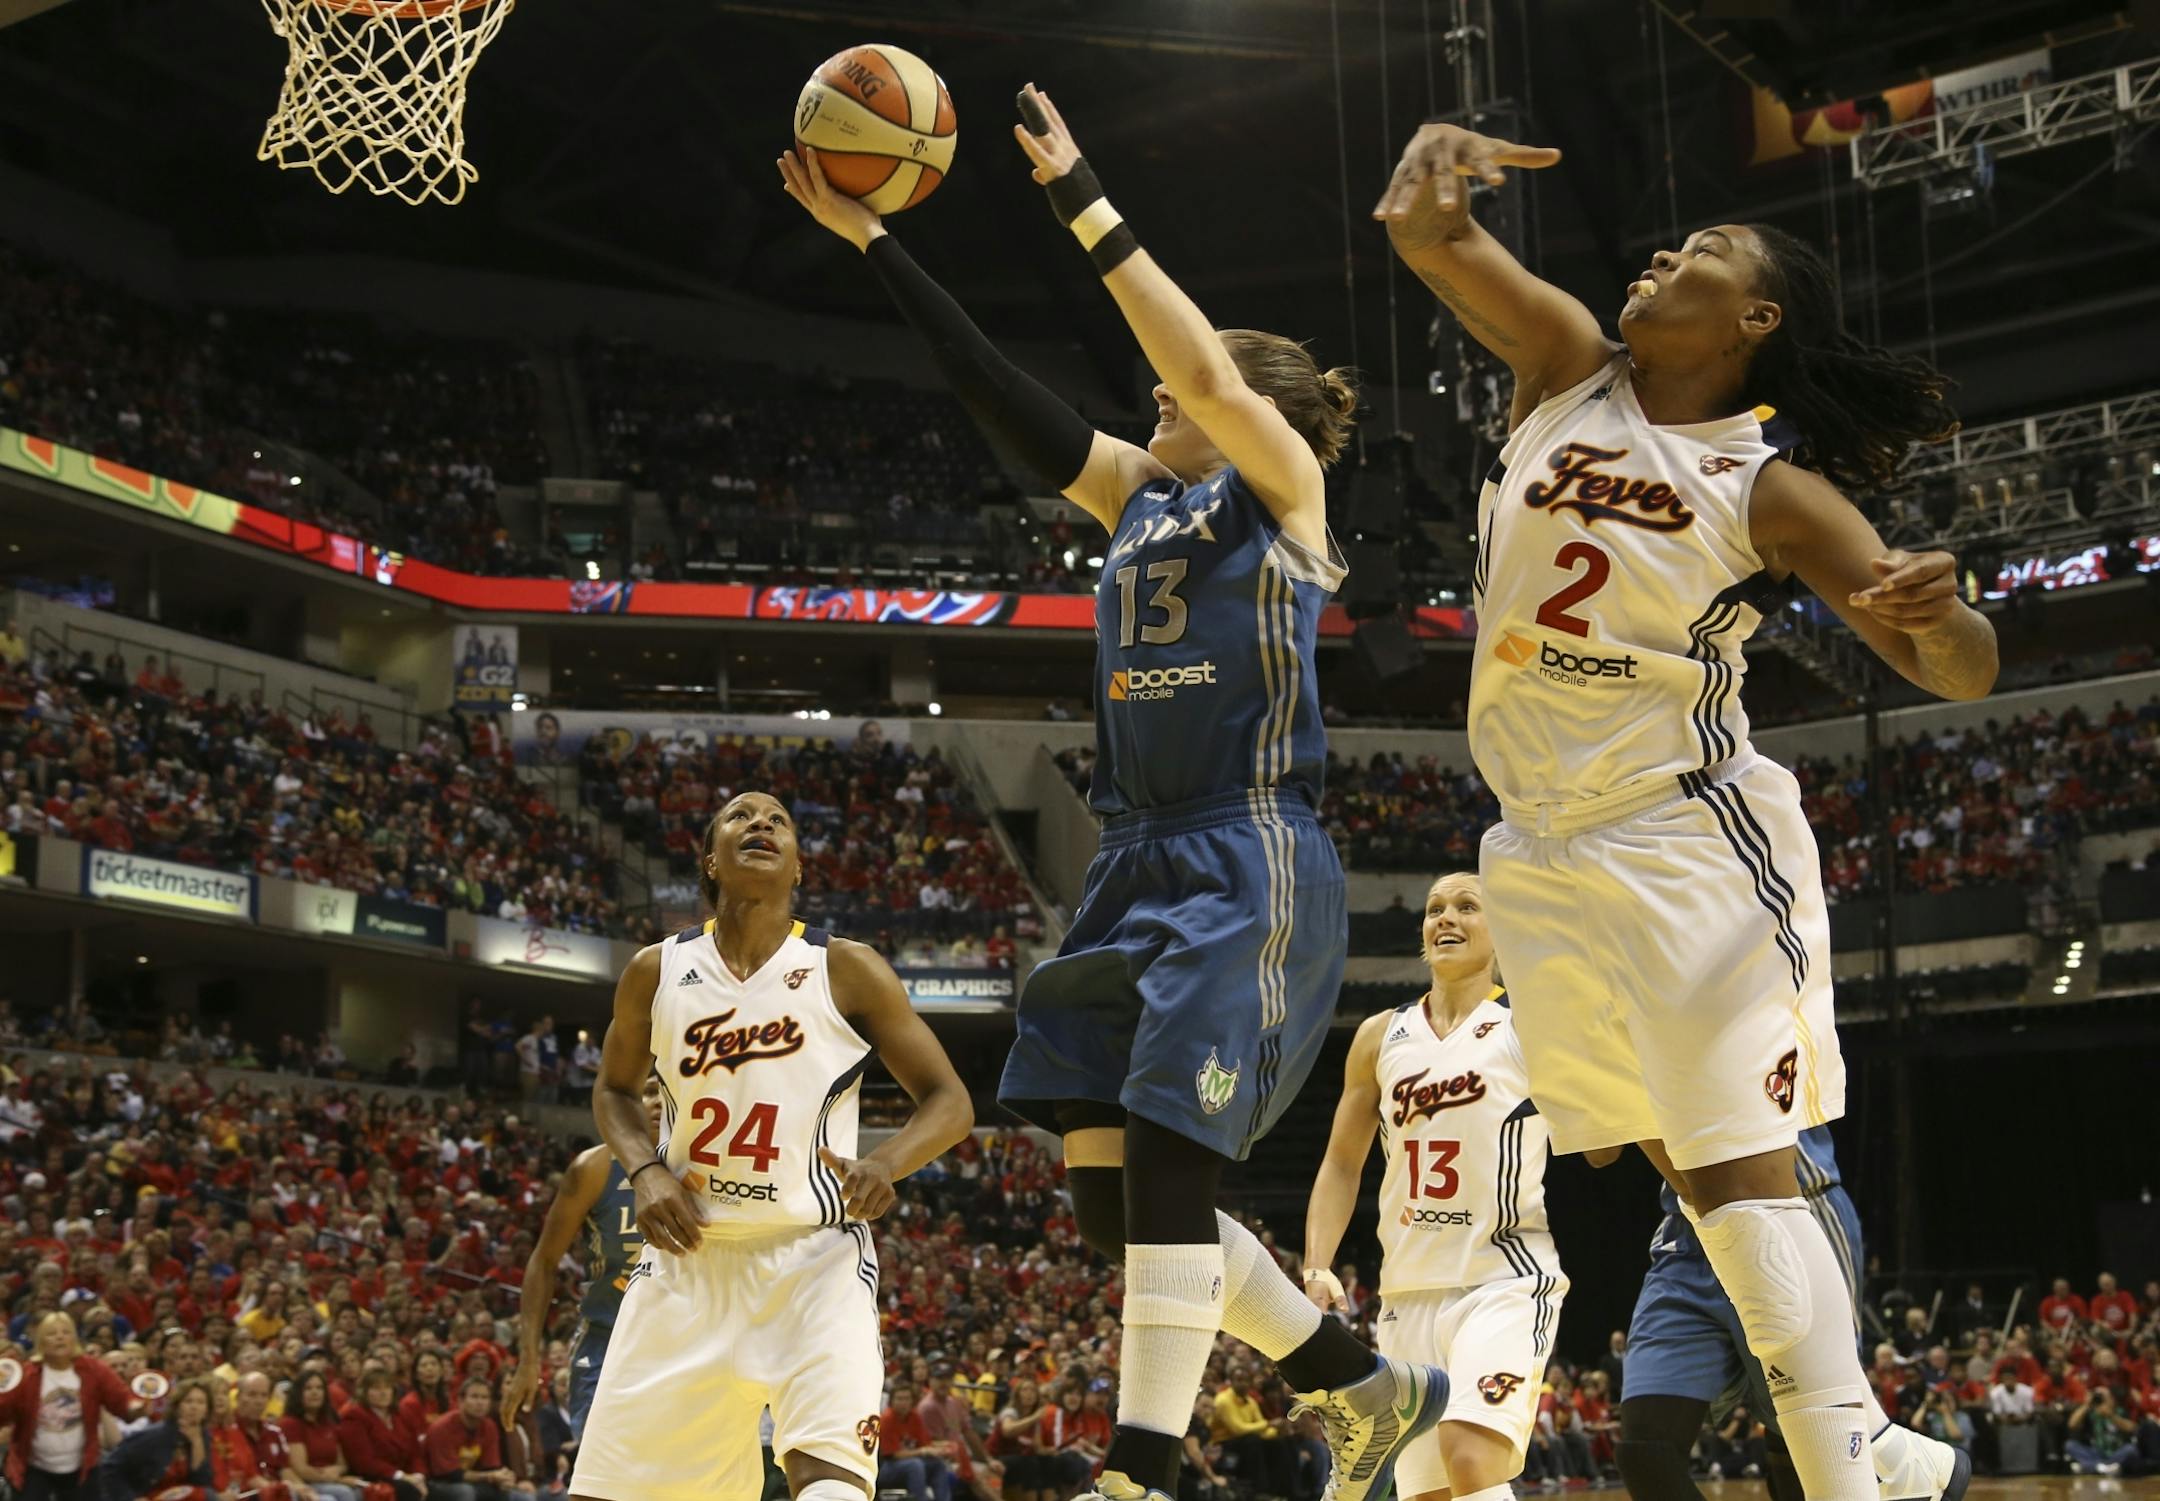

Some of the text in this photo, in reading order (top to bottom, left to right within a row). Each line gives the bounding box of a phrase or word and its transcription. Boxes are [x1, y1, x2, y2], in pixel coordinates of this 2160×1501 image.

[1115, 558, 1189, 649] 13
[1535, 541, 1611, 638] 2
[480, 665, 514, 686] G2
[1127, 661, 1217, 690] boost
[1539, 667, 1588, 689] mobile
[1541, 641, 1638, 679] boost
[1128, 686, 1175, 702] mobile
[94, 857, 248, 905] ticketmaster
[914, 979, 1014, 996] GRAPHICS
[680, 1008, 805, 1078] Fever
[1392, 1067, 1486, 1128] Fever
[689, 1097, 780, 1173] 24
[709, 1174, 779, 1202] boost
[1404, 1140, 1461, 1200] 13
[710, 1194, 742, 1207] mobile
